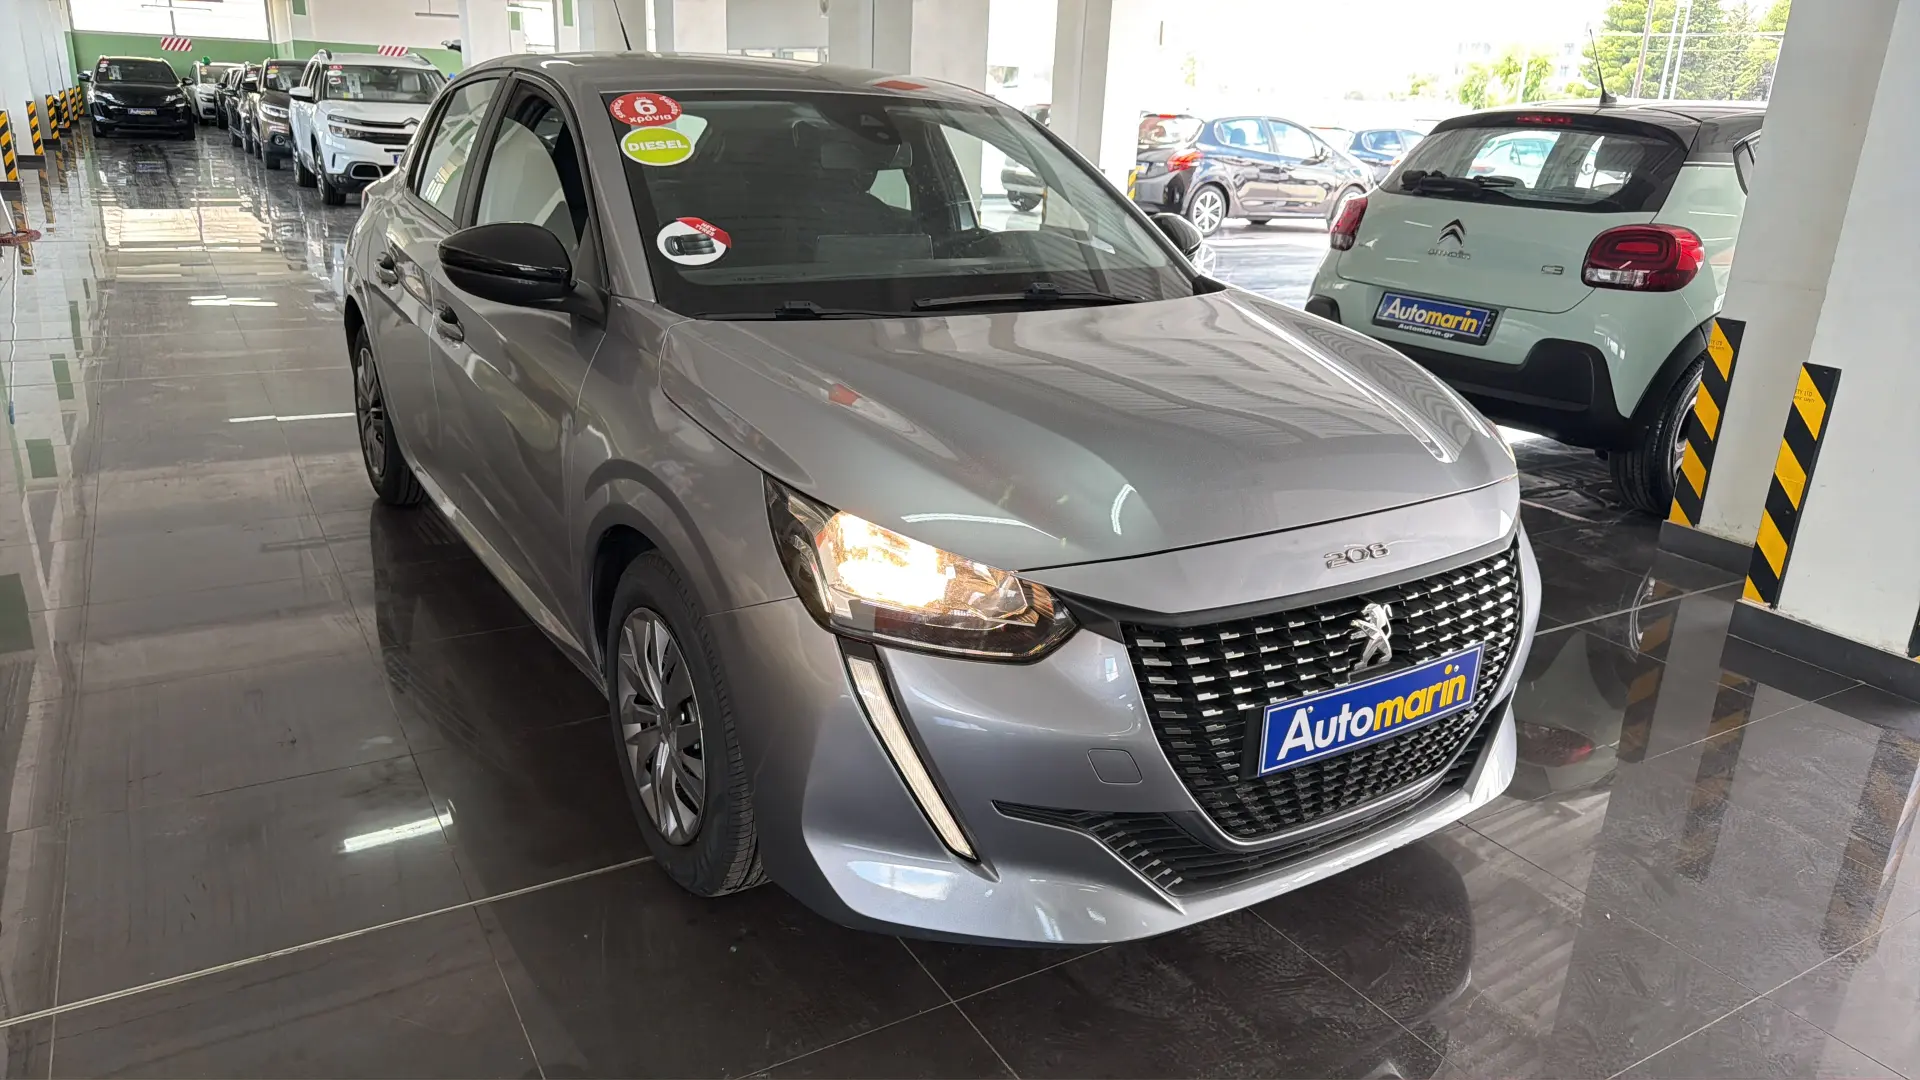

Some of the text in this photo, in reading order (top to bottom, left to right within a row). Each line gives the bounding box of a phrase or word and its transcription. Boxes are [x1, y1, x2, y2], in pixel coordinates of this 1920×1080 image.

[634, 98, 658, 115] 6
[628, 114, 673, 123] χρόνια
[627, 139, 689, 152] DIESEL
[695, 224, 716, 237] TYRES
[701, 222, 717, 231] NEW
[1383, 298, 1479, 333] Automarin
[1397, 323, 1455, 339] Automarin.gr
[1323, 543, 1390, 569] 208
[1276, 664, 1467, 761] Automarin
